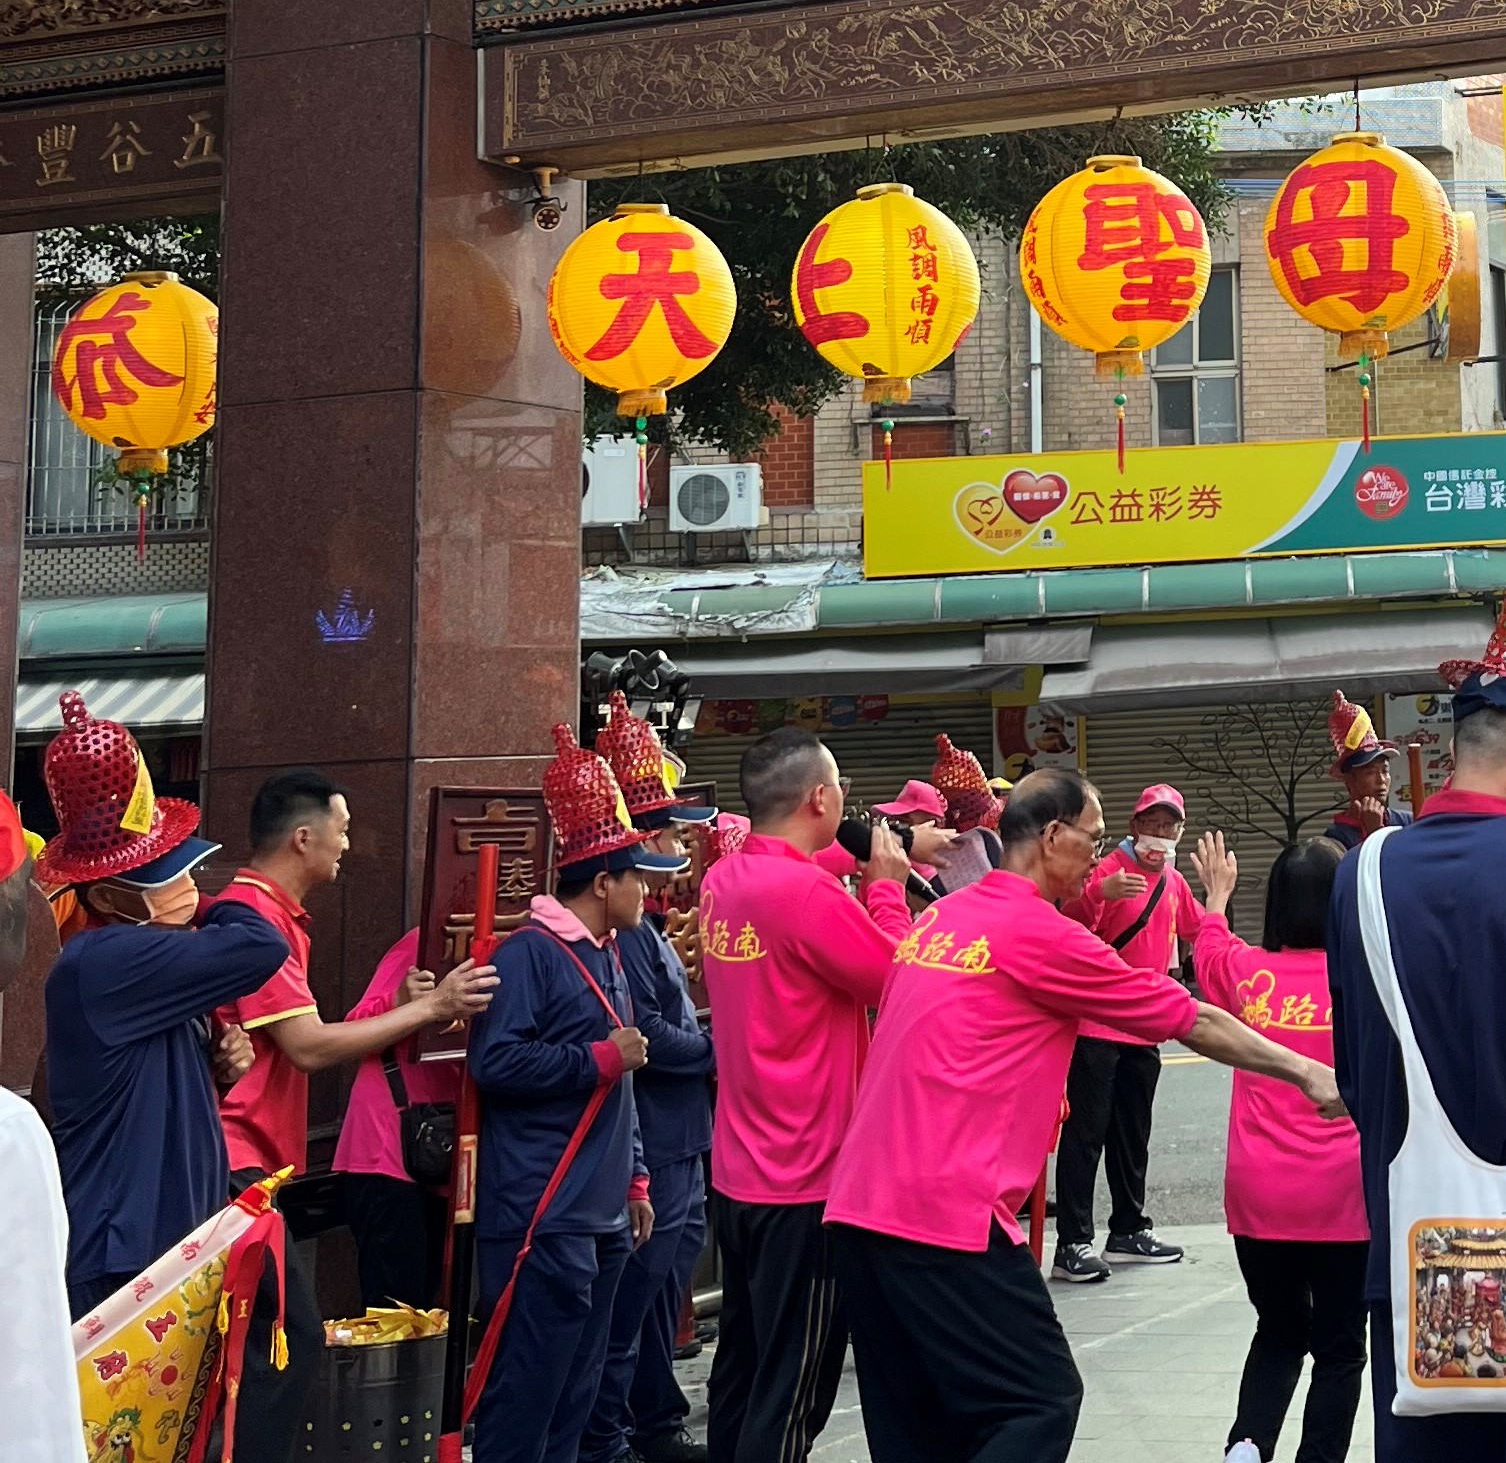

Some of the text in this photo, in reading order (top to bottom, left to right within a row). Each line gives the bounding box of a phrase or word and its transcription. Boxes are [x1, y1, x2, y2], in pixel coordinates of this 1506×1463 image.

[0, 110, 224, 187] 五谷豐
[585, 232, 719, 362] 天
[799, 223, 871, 349] 上
[905, 224, 938, 346] 風調雨順
[1077, 182, 1204, 323] 聖
[1269, 159, 1410, 314] 母
[1068, 484, 1223, 525] 公益彩券
